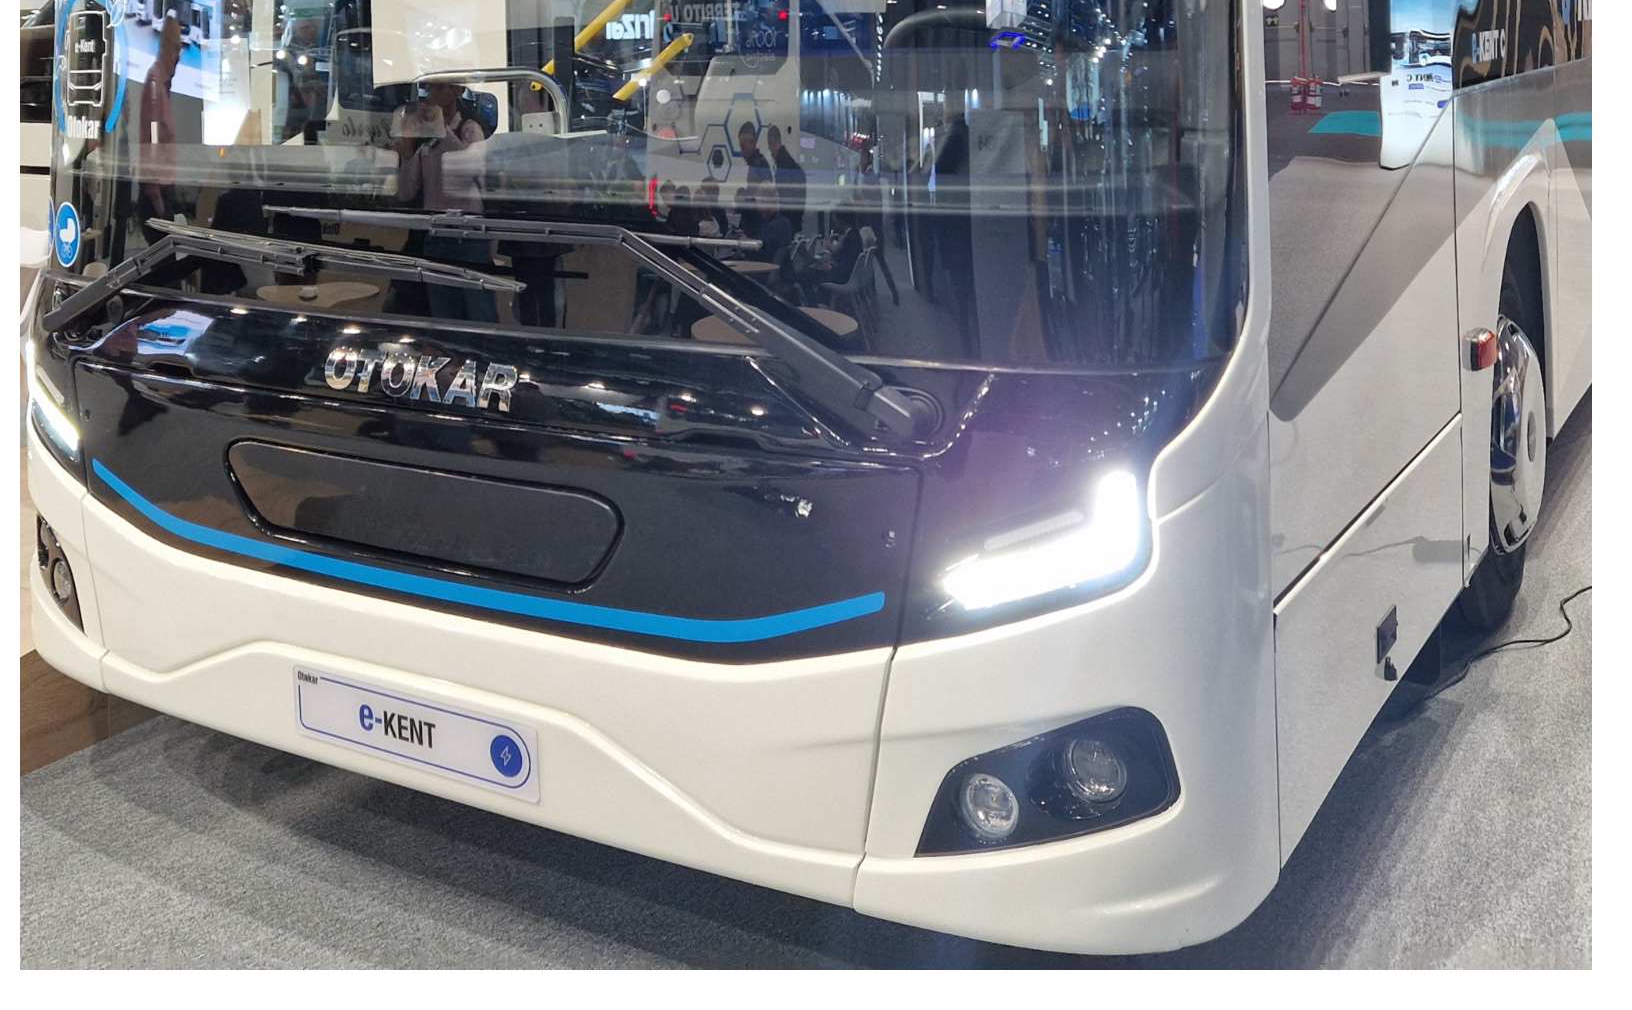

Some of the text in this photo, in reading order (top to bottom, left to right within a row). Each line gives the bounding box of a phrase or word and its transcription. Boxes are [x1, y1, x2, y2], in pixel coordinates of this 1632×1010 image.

[68, 116, 101, 140] Otokar
[324, 346, 519, 413] OTOKAR
[297, 670, 319, 685] Otokar
[358, 703, 437, 749] e-KENT
